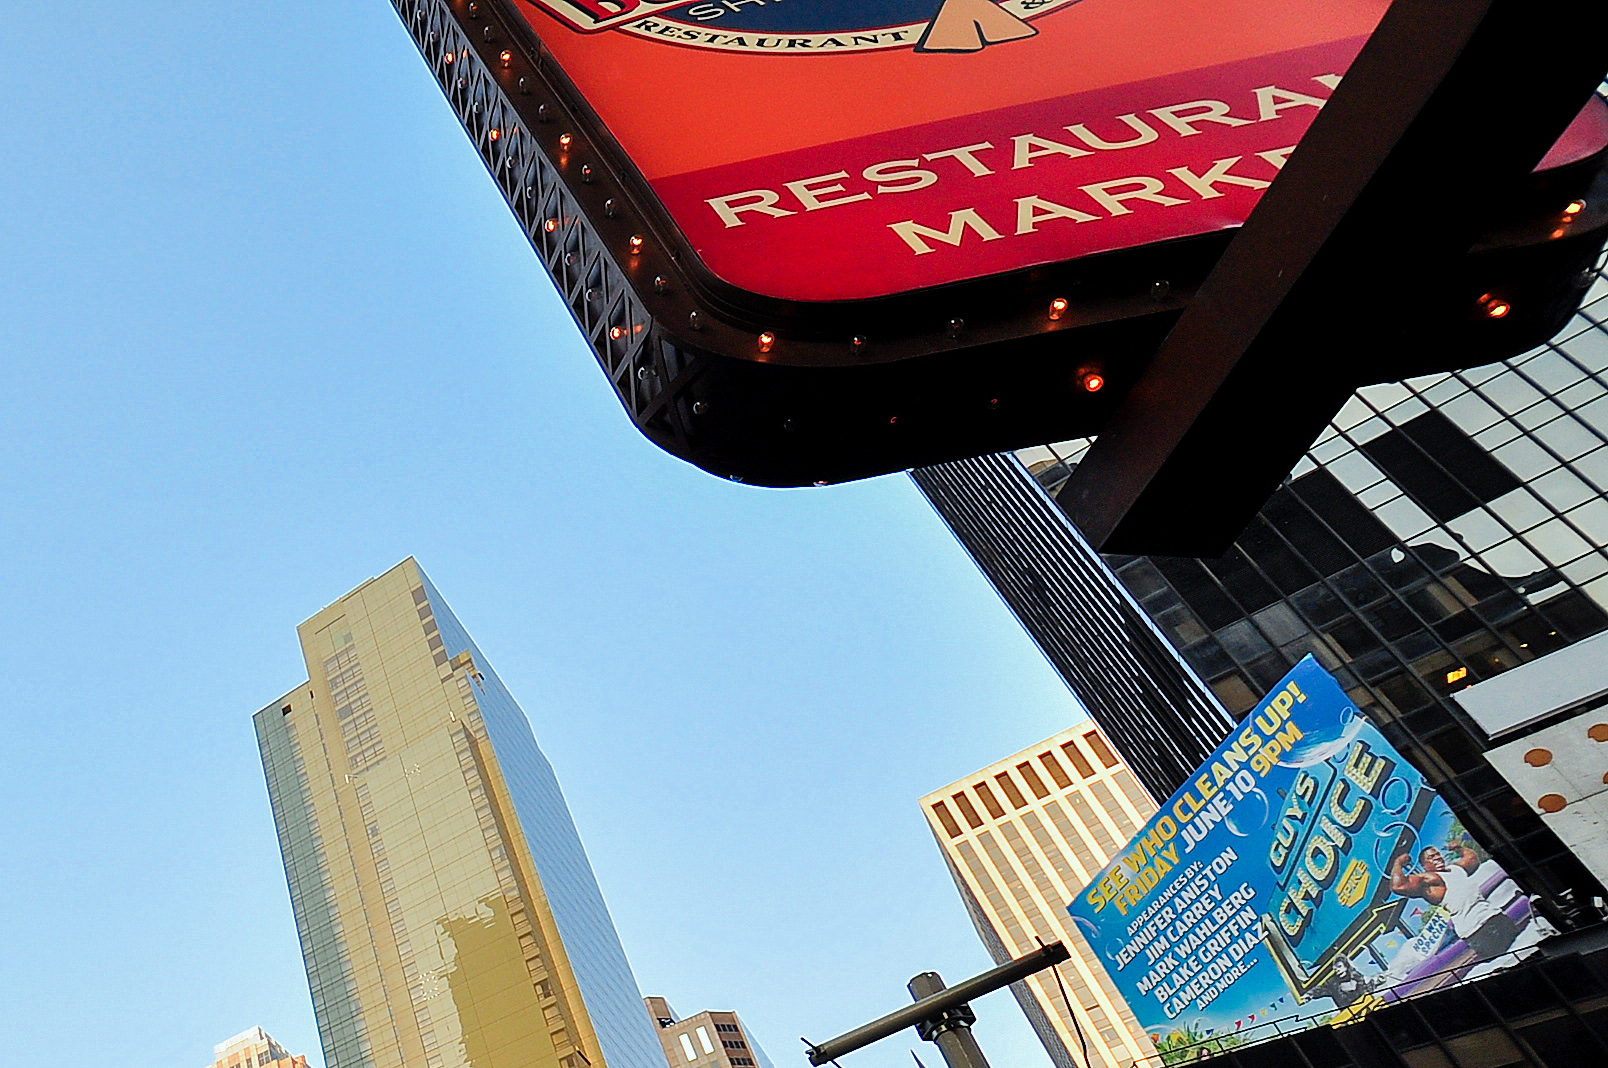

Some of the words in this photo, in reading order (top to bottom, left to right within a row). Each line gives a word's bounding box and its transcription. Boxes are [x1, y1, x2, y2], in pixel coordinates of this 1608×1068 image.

[635, 18, 911, 51] RESTAURANT
[1087, 865, 1130, 914] SEE
[1123, 815, 1179, 873] WHO
[1173, 727, 1264, 824] CLEANS
[1254, 680, 1308, 737] UP!
[1114, 842, 1181, 916] FRIDAY
[1179, 792, 1234, 854] JUNE
[1225, 768, 1257, 802] 10
[1249, 720, 1305, 778] 9PM
[1269, 772, 1316, 868] GUYS
[1278, 740, 1390, 938] CHOICE
[1114, 903, 1178, 971] JENNIFER
[1174, 846, 1239, 914] ANISTON
[1126, 871, 1189, 937] APPEARANCES
[1185, 860, 1205, 879] BY:
[1136, 951, 1180, 996] MARK
[1174, 882, 1257, 960] WAHLBERG
[1144, 936, 1172, 966] JIM
[1166, 883, 1225, 943] CARREY
[1413, 929, 1430, 953] HOT
[1427, 912, 1444, 932] WAX
[1420, 920, 1448, 955] SPECIAL
[1153, 956, 1203, 1004] BLAKE
[1198, 905, 1259, 964] GRIFFIN
[1163, 953, 1234, 1020] CAMERON
[1231, 921, 1270, 963] DIAZ
[1195, 986, 1220, 1011] AND
[1216, 957, 1259, 994] MORE...
